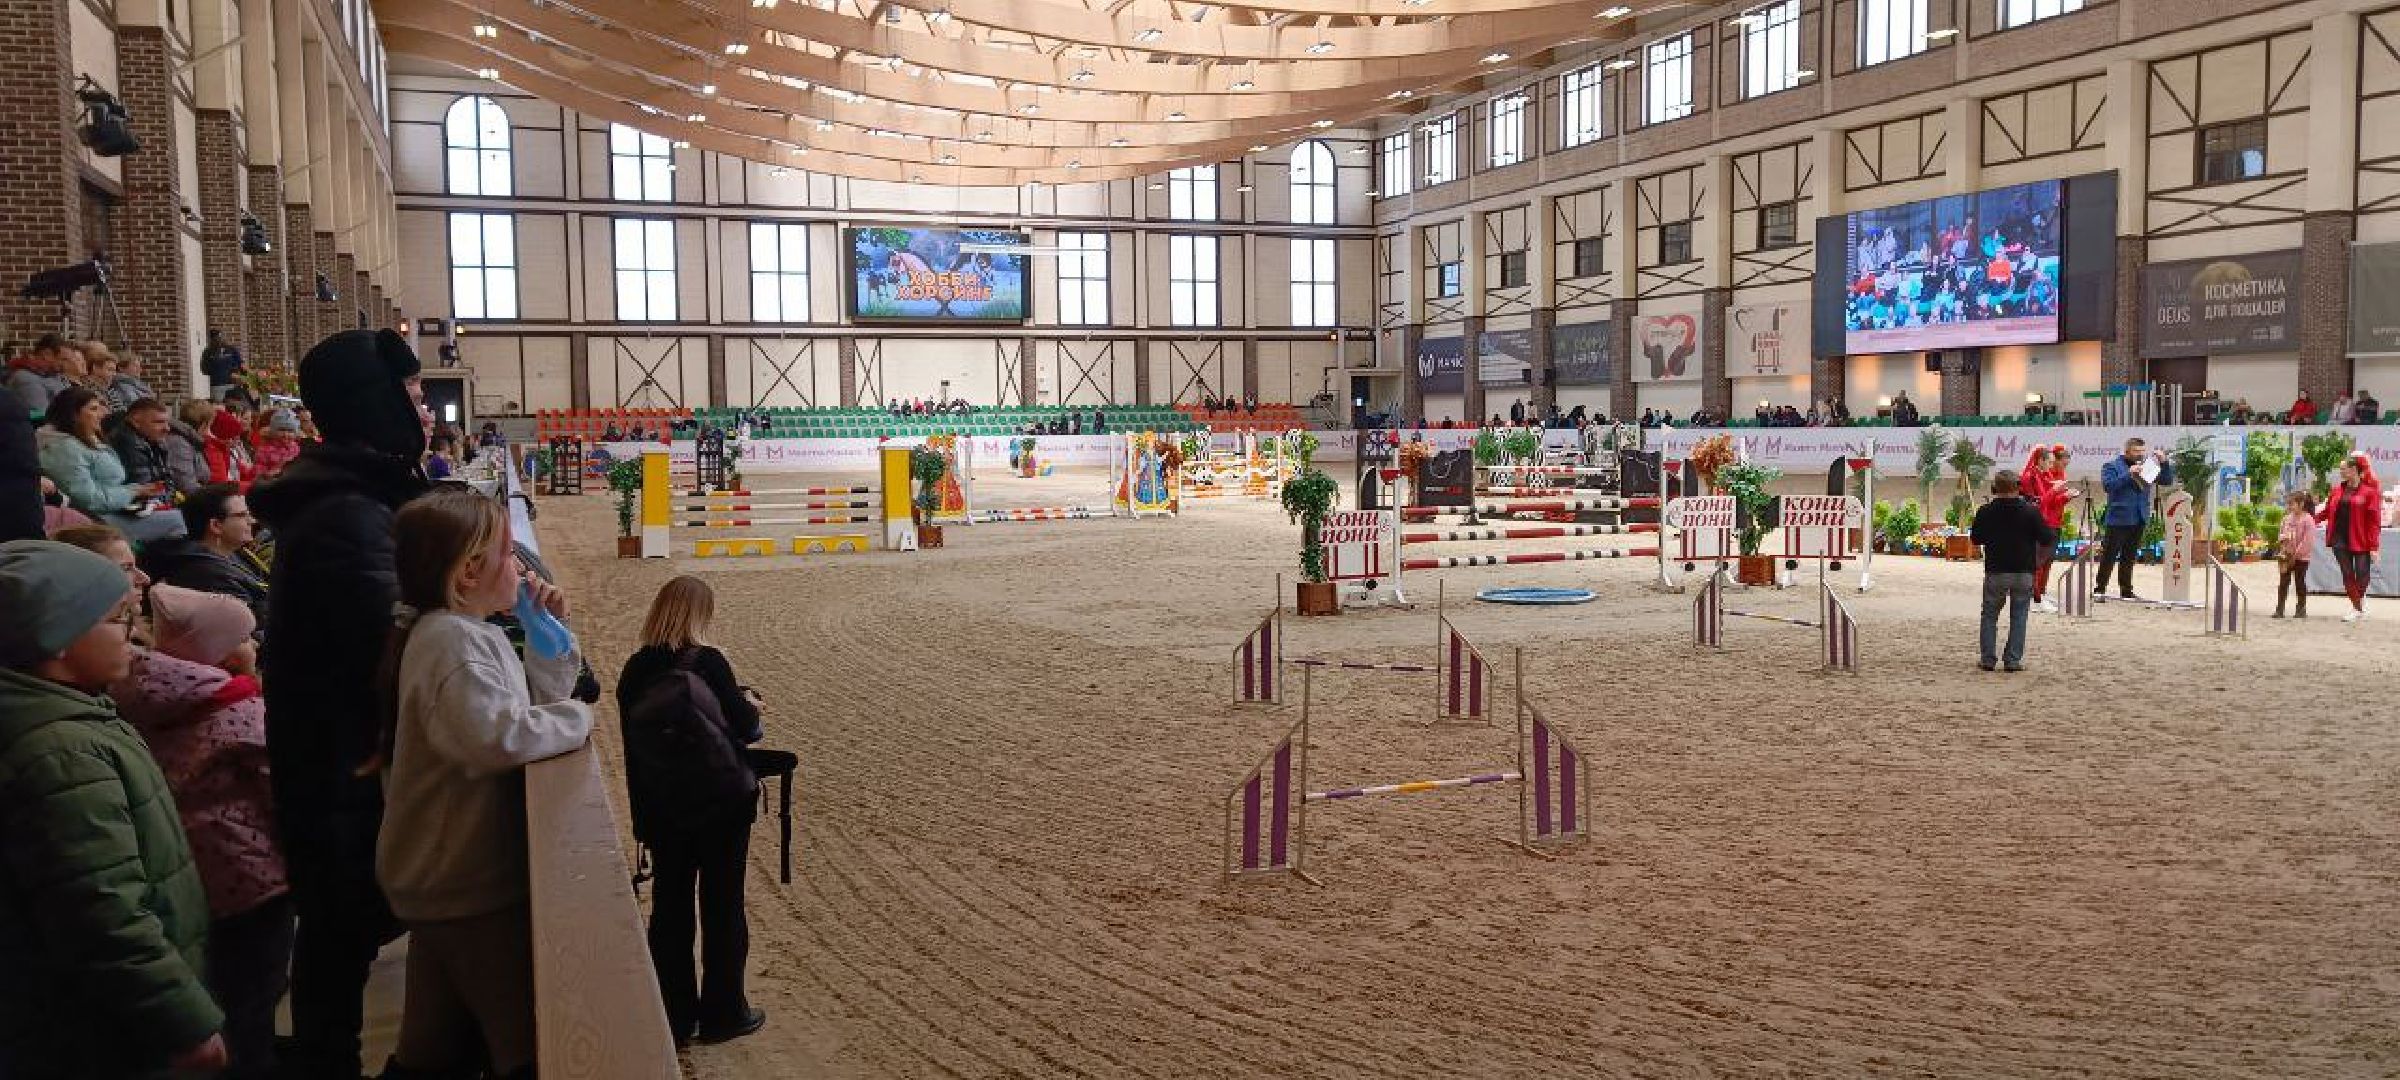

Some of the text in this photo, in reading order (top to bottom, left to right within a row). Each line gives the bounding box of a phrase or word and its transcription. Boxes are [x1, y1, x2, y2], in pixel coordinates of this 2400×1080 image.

[2205, 278, 2286, 300] КОСМЕТИКА
[2158, 306, 2191, 325] DEUS
[2204, 298, 2286, 320] ДЛЯ ЛОШАДЕЙ
[1684, 499, 1733, 511] КОНИ
[1784, 497, 1846, 511] КОНИ
[1321, 512, 1379, 526] КОНИ
[1682, 514, 1733, 527] ПОНИ
[1783, 512, 1846, 526] ПОНИ
[2172, 522, 2183, 586] СТАРТ
